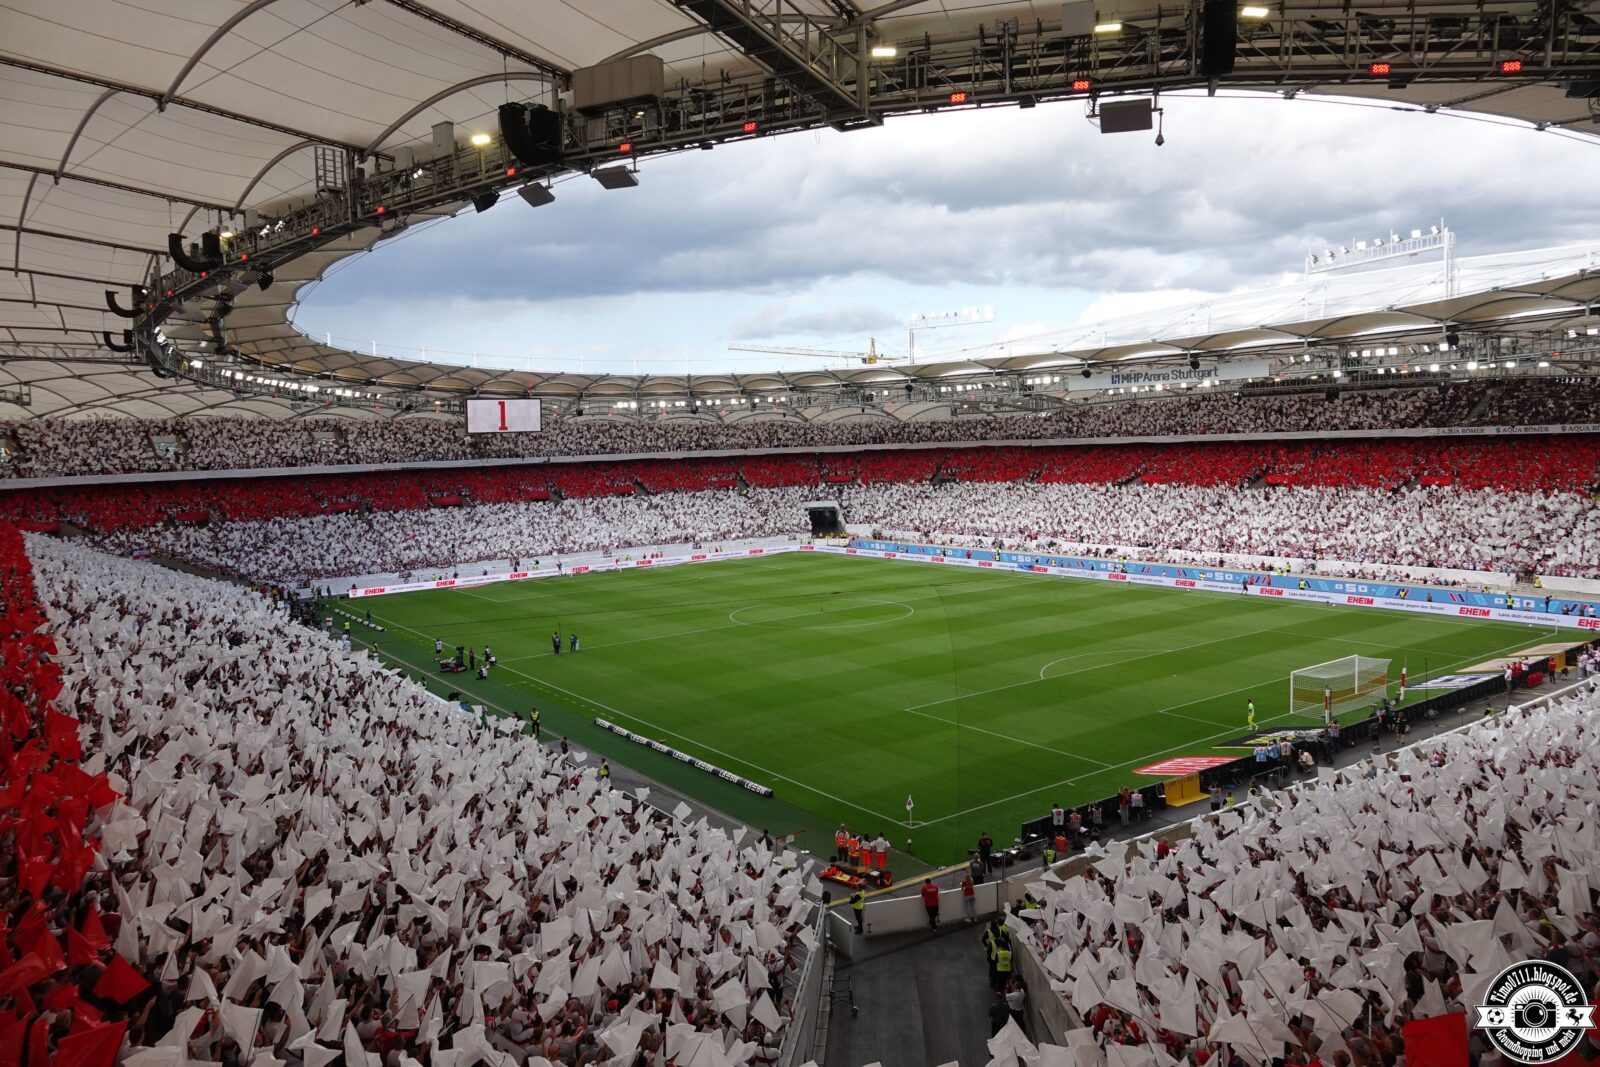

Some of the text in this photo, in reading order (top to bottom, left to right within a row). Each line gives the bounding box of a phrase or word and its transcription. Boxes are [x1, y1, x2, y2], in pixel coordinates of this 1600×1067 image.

[1171, 366, 1219, 380] Stuttgart
[498, 401, 508, 430] 1
[572, 566, 590, 574] EHEIM
[508, 572, 529, 580] EHEIM
[1108, 573, 1127, 581] EHEIM
[1175, 580, 1196, 588] EHEIM
[364, 587, 385, 595] EHEIM
[1260, 587, 1284, 596] EHEIM
[1347, 596, 1374, 605] EHEIM
[1459, 607, 1490, 616] EHEIM
